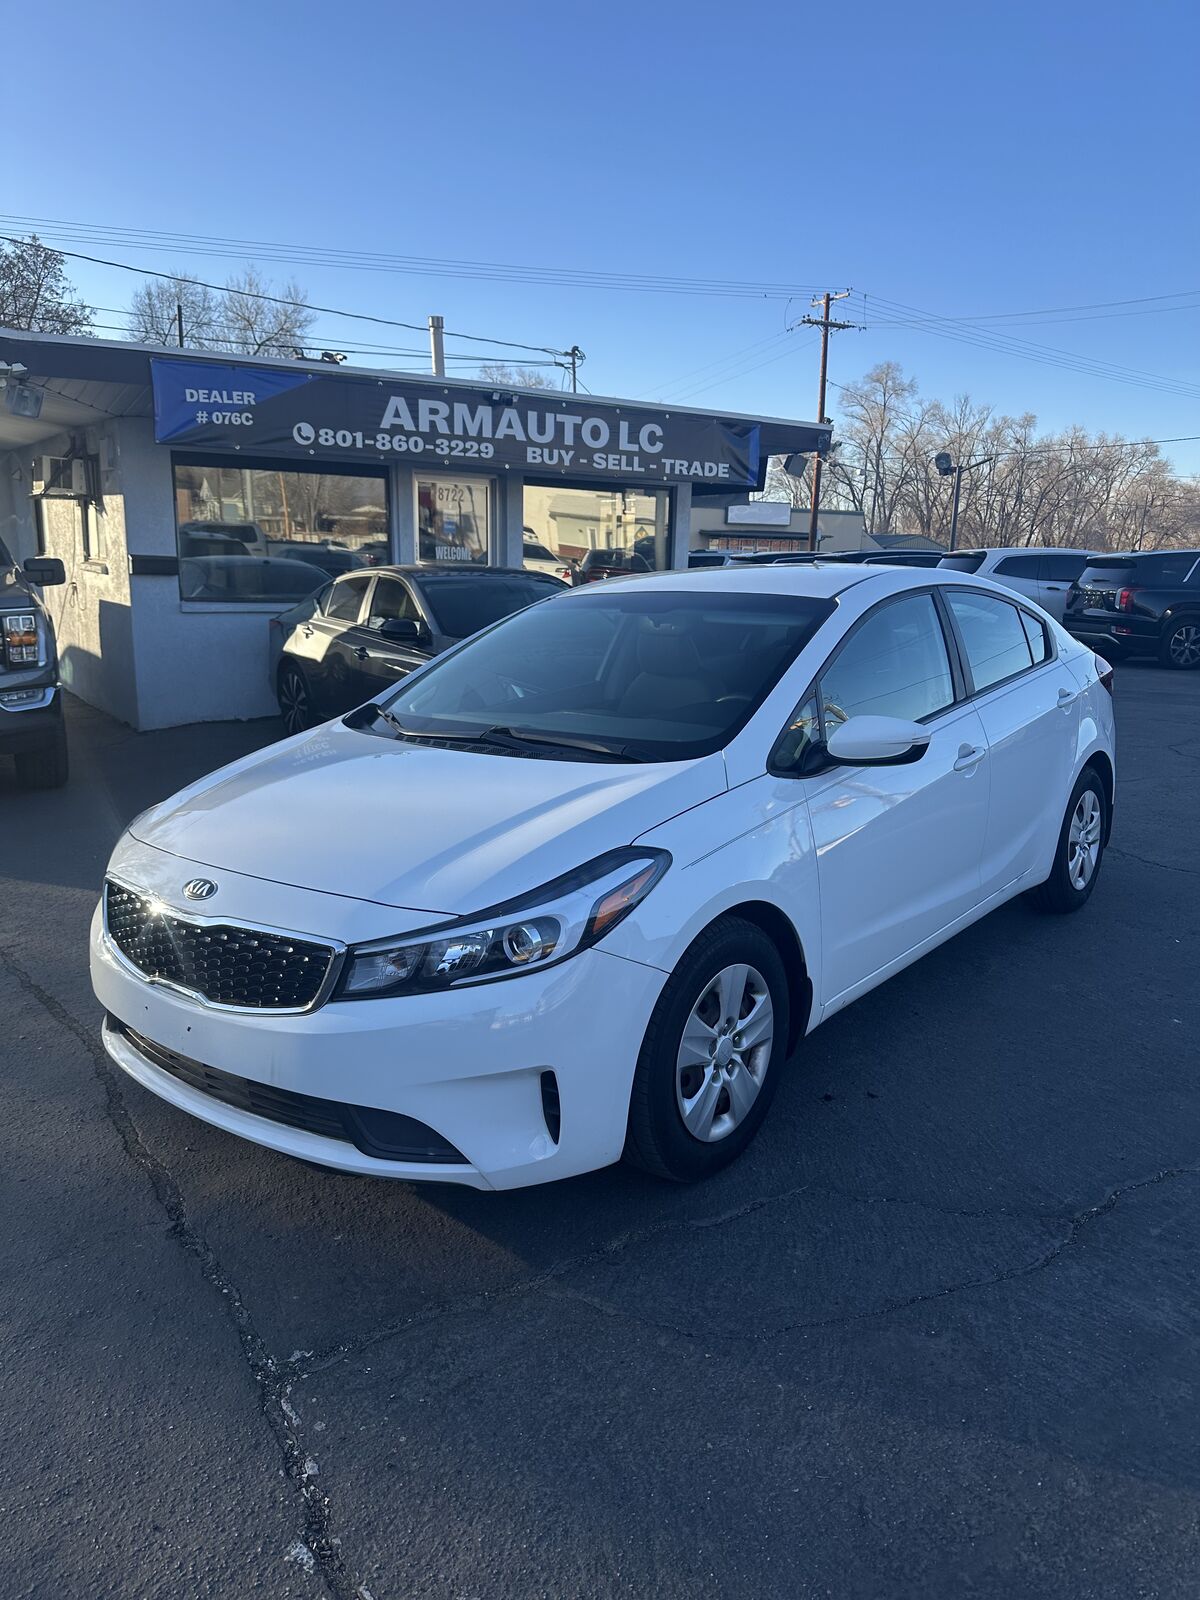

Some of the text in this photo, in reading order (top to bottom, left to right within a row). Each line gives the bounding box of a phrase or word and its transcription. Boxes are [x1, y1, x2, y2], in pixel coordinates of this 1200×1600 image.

[185, 389, 256, 405] DEALER
[196, 411, 254, 426] # 076C
[380, 396, 664, 454] ARMAUTO LC
[318, 428, 495, 459] 801-860-3229
[526, 447, 575, 465] BUY
[592, 453, 645, 472] SELL
[661, 458, 730, 478] TRADE
[438, 487, 464, 502] 8722
[435, 546, 472, 560] WELCOME
[185, 879, 211, 896] KIA
